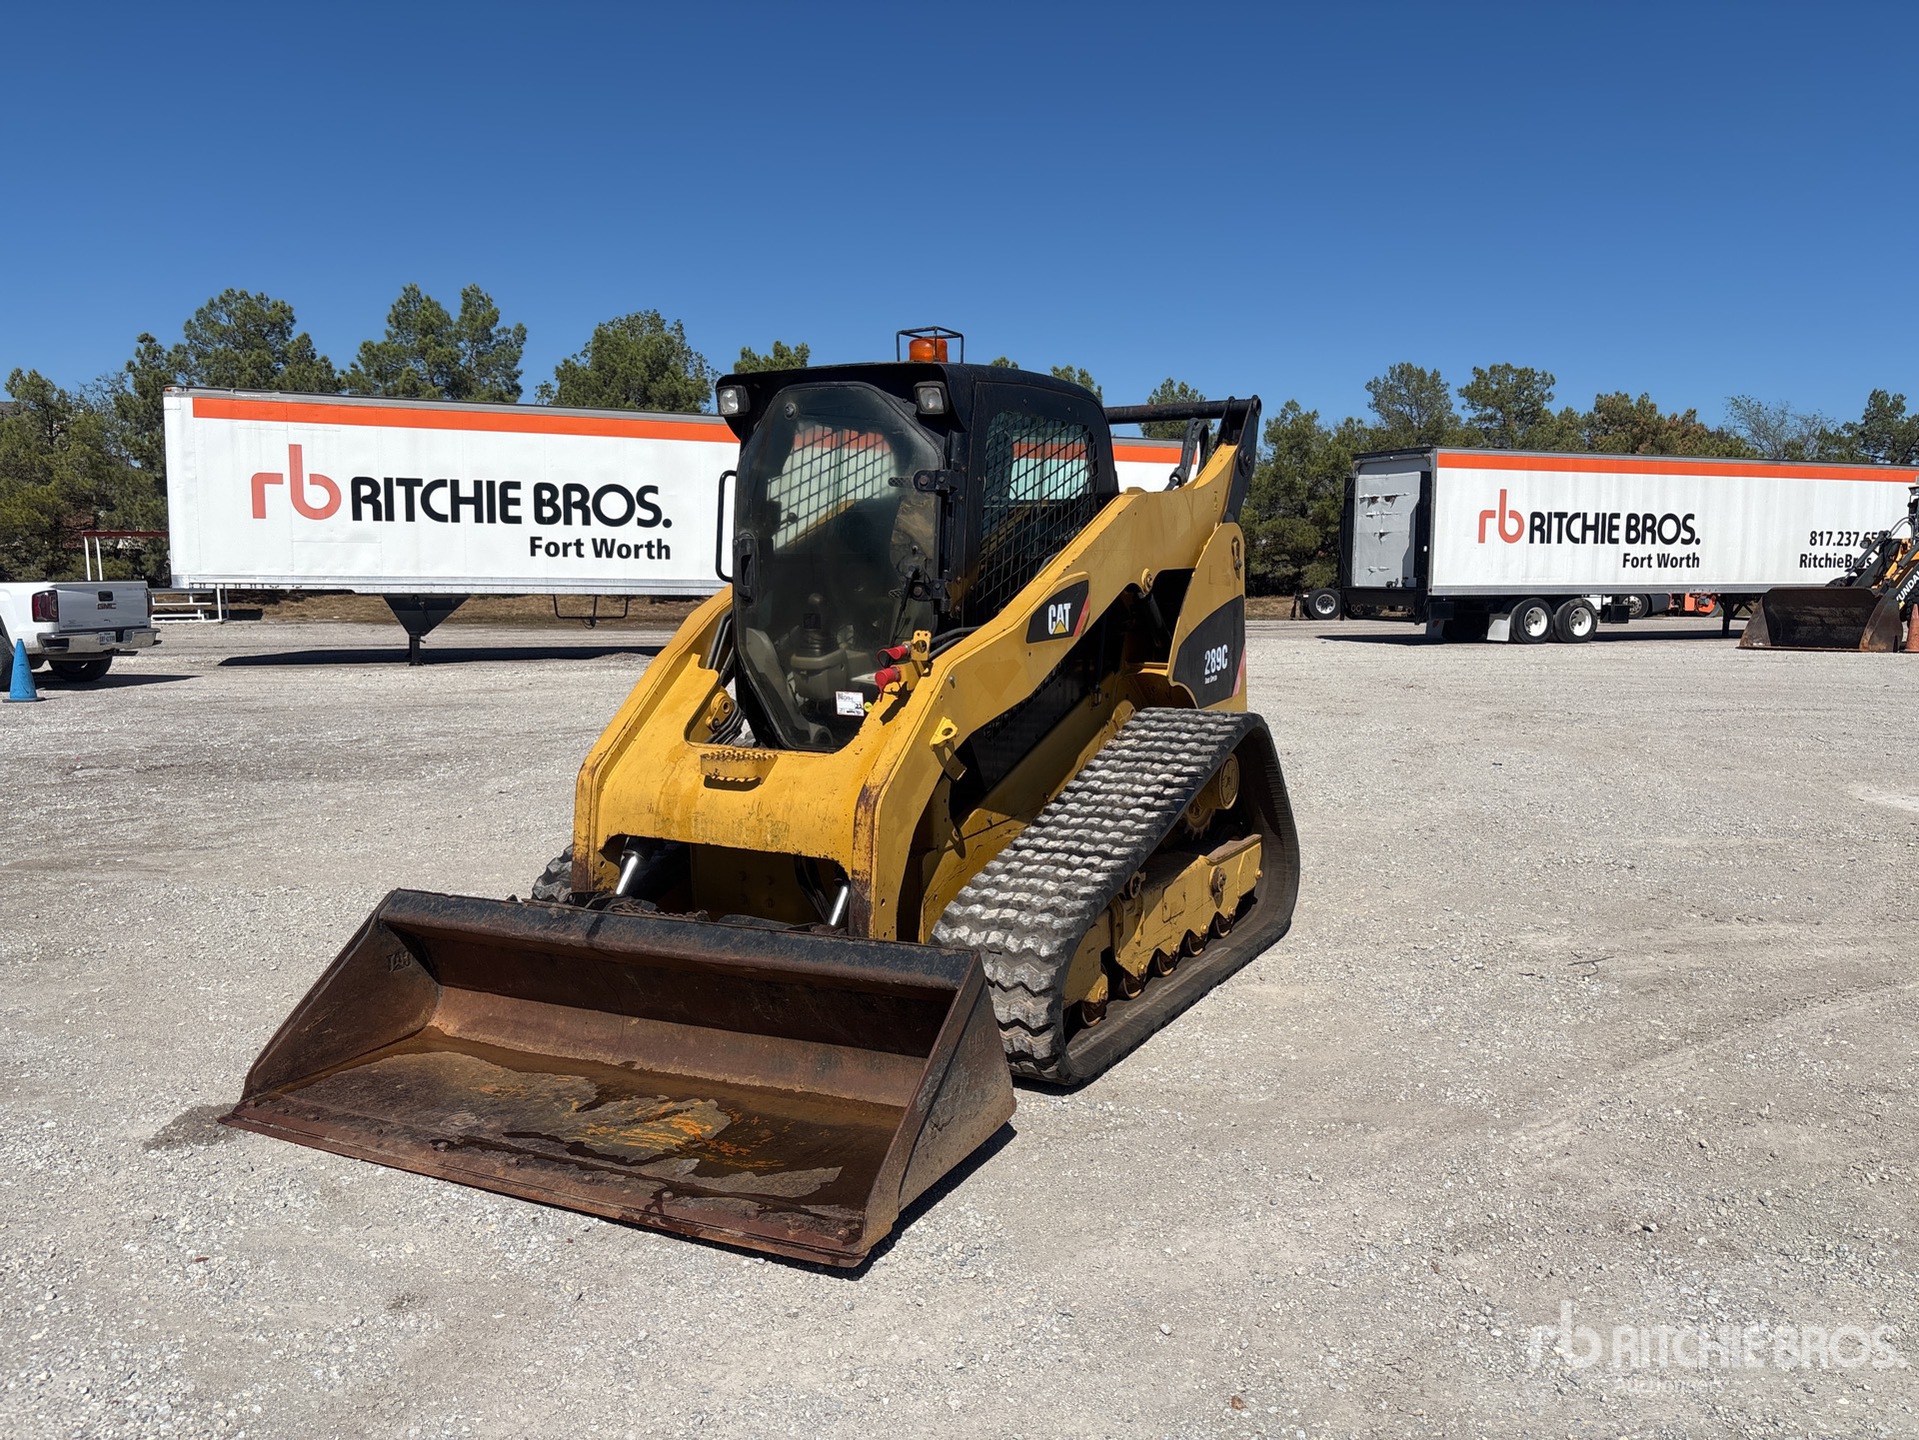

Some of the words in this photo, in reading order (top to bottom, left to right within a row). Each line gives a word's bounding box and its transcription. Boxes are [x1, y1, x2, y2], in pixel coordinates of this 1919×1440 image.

[252, 444, 341, 520] rb
[351, 477, 522, 524] RITCHIE
[534, 483, 672, 528] BROS.
[1478, 489, 1524, 544] rb
[1529, 512, 1620, 544] RITCHIE
[1626, 513, 1700, 545] BROS.
[530, 537, 584, 558] Fort
[592, 538, 670, 560] Worth
[1622, 553, 1652, 568] Fort
[1657, 553, 1700, 568] Worth
[1048, 603, 1072, 634] CAT
[1204, 644, 1228, 675] 289C
